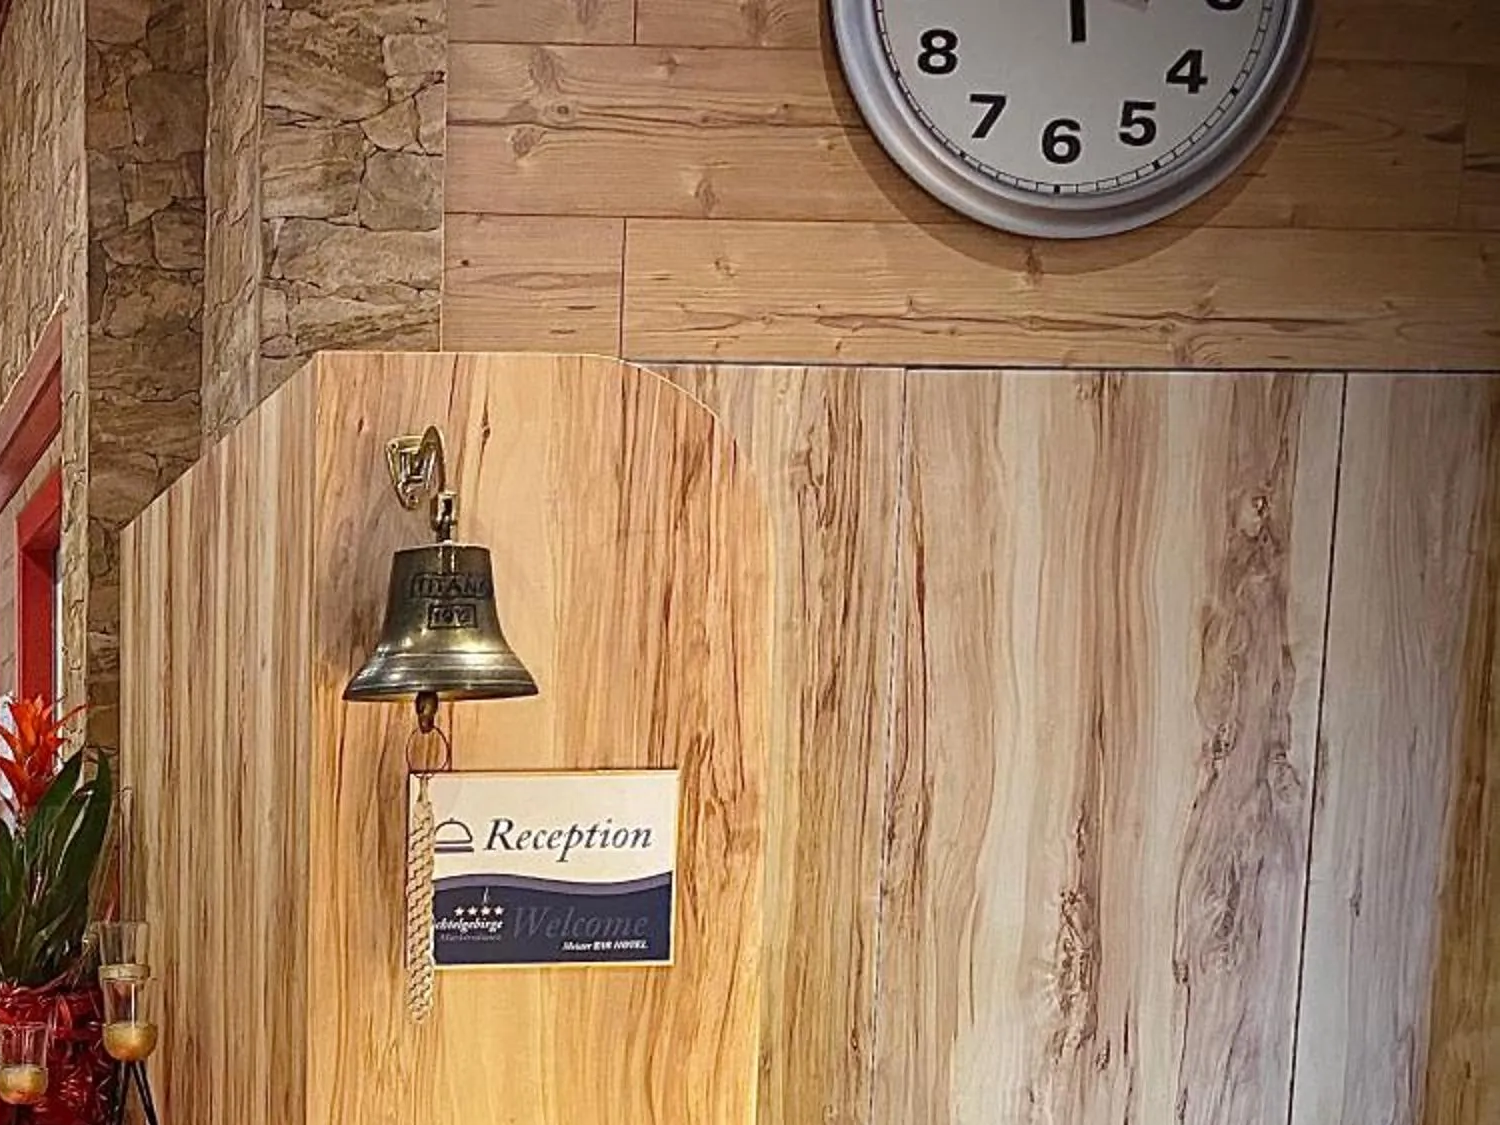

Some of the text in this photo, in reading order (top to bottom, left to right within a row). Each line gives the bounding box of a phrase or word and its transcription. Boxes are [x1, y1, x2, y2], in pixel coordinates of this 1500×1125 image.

[917, 29, 958, 75] 8
[1165, 48, 1208, 94] 4
[969, 93, 1007, 139] 7
[1118, 101, 1157, 146] 5
[1041, 119, 1081, 165] 6
[483, 818, 653, 863] Reception
[514, 906, 648, 938] Welcome
